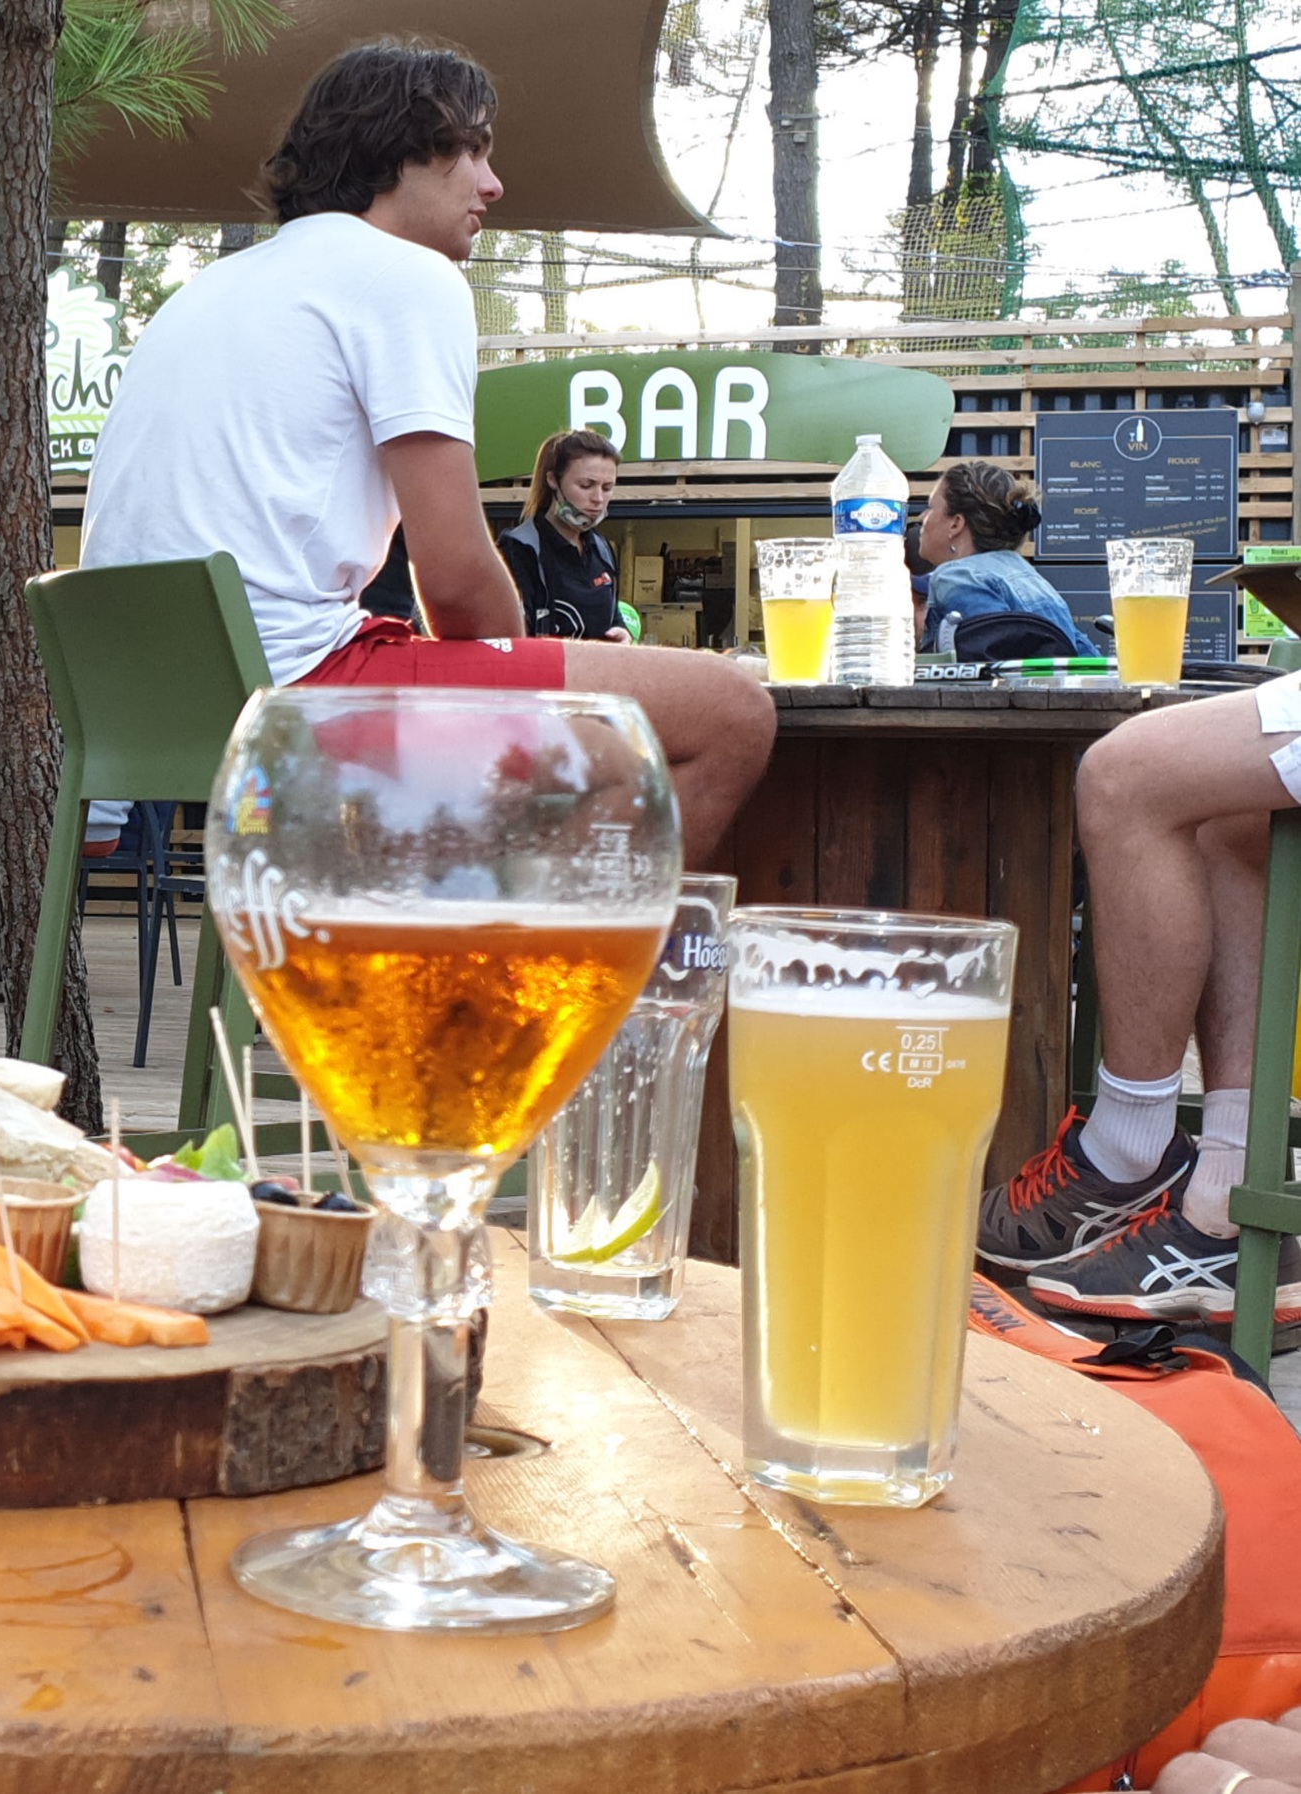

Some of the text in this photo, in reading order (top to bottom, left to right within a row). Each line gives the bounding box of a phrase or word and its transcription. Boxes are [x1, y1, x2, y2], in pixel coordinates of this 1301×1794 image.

[570, 366, 769, 459] BAR
[1128, 442, 1148, 451] VIN
[1070, 460, 1102, 468] BLANC
[1167, 457, 1201, 465] ROUGE
